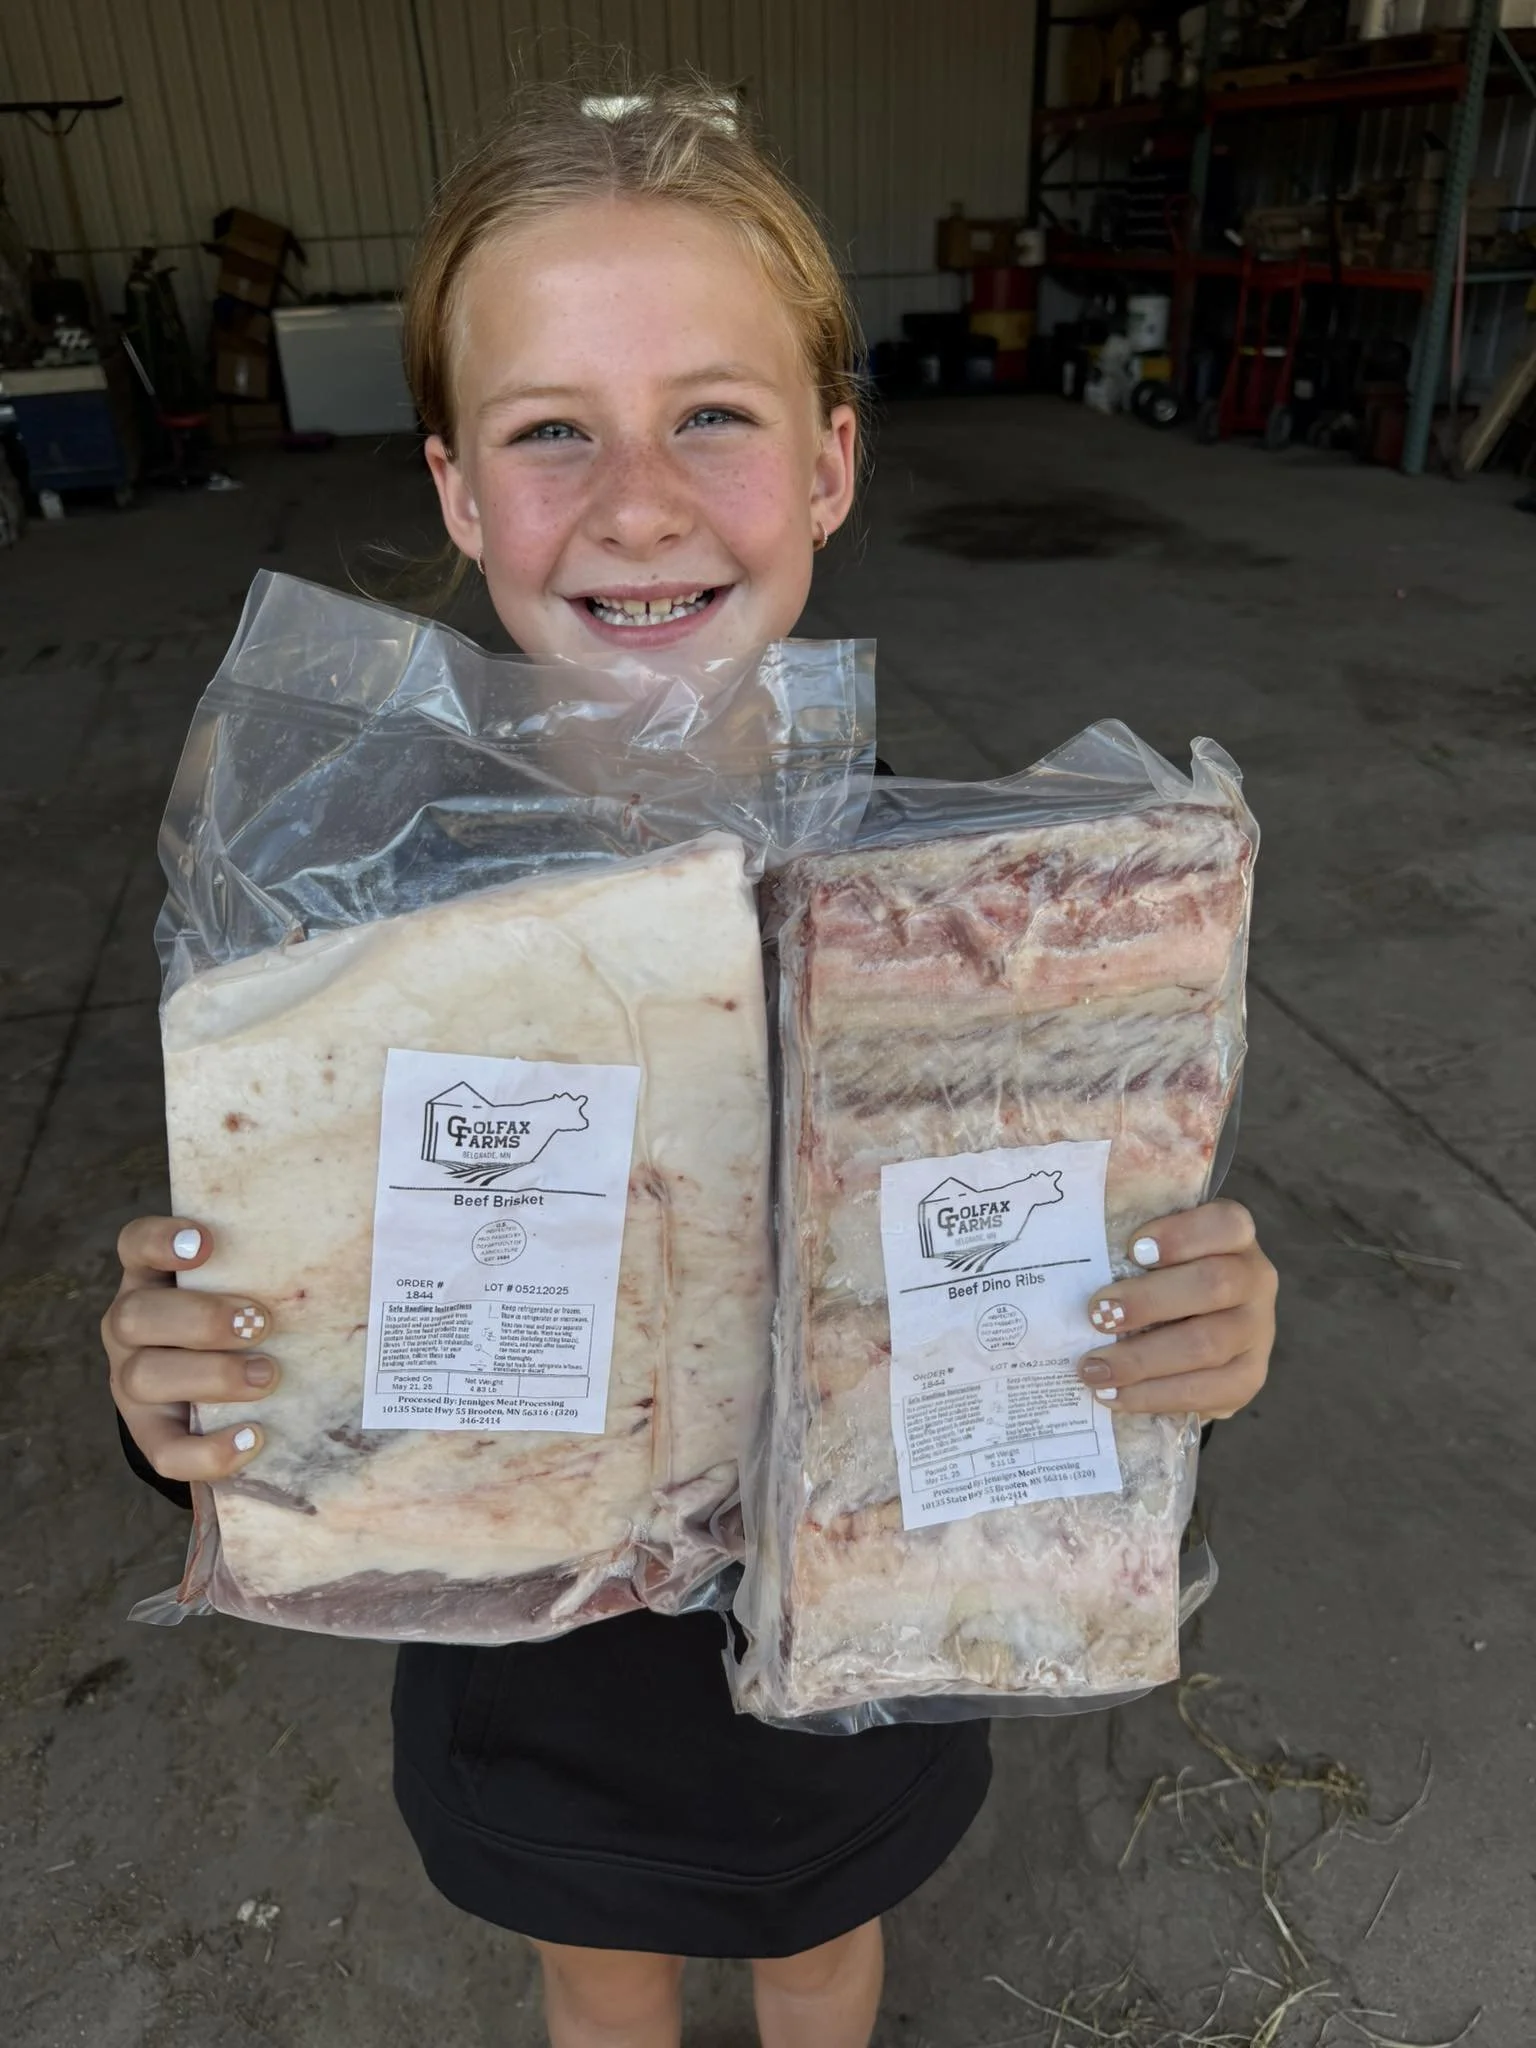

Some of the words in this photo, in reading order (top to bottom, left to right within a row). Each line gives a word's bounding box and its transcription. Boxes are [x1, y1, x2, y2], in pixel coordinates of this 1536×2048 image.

[455, 1125, 521, 1149] FARMS
[453, 1194, 488, 1207] Beef
[493, 1194, 544, 1207] Brisket
[945, 1214, 1003, 1237] FARMS
[396, 1279, 434, 1289] ORDER
[437, 1280, 444, 1289] #
[484, 1283, 504, 1293] LOT
[506, 1284, 514, 1293] #
[515, 1285, 569, 1296] 05212025
[948, 1282, 979, 1300] Beef
[982, 1276, 1011, 1293] Dino
[1015, 1272, 1046, 1288] Ribs
[405, 1291, 434, 1300] 1844
[501, 1304, 517, 1312] Keep
[517, 1305, 553, 1314] refrigerated
[912, 1369, 946, 1381] ORDER
[392, 1383, 408, 1391] May
[478, 1378, 504, 1387] Weight
[398, 1395, 442, 1404] Processed
[446, 1396, 458, 1405] By:
[458, 1397, 495, 1407] Jenniges
[496, 1398, 518, 1407] Meat
[519, 1399, 565, 1408] Processing
[382, 1405, 410, 1414] 10135
[411, 1405, 434, 1414] State
[434, 1406, 454, 1416] Hwy
[455, 1407, 466, 1415] 55
[506, 1408, 520, 1416] MN
[521, 1409, 549, 1417] 56316
[554, 1408, 579, 1417] (320)
[459, 1416, 501, 1425] 346-2414
[932, 1481, 973, 1498] Processed
[1017, 1467, 1037, 1478] Meat
[1037, 1461, 1080, 1474] Processing
[945, 1494, 968, 1505] State
